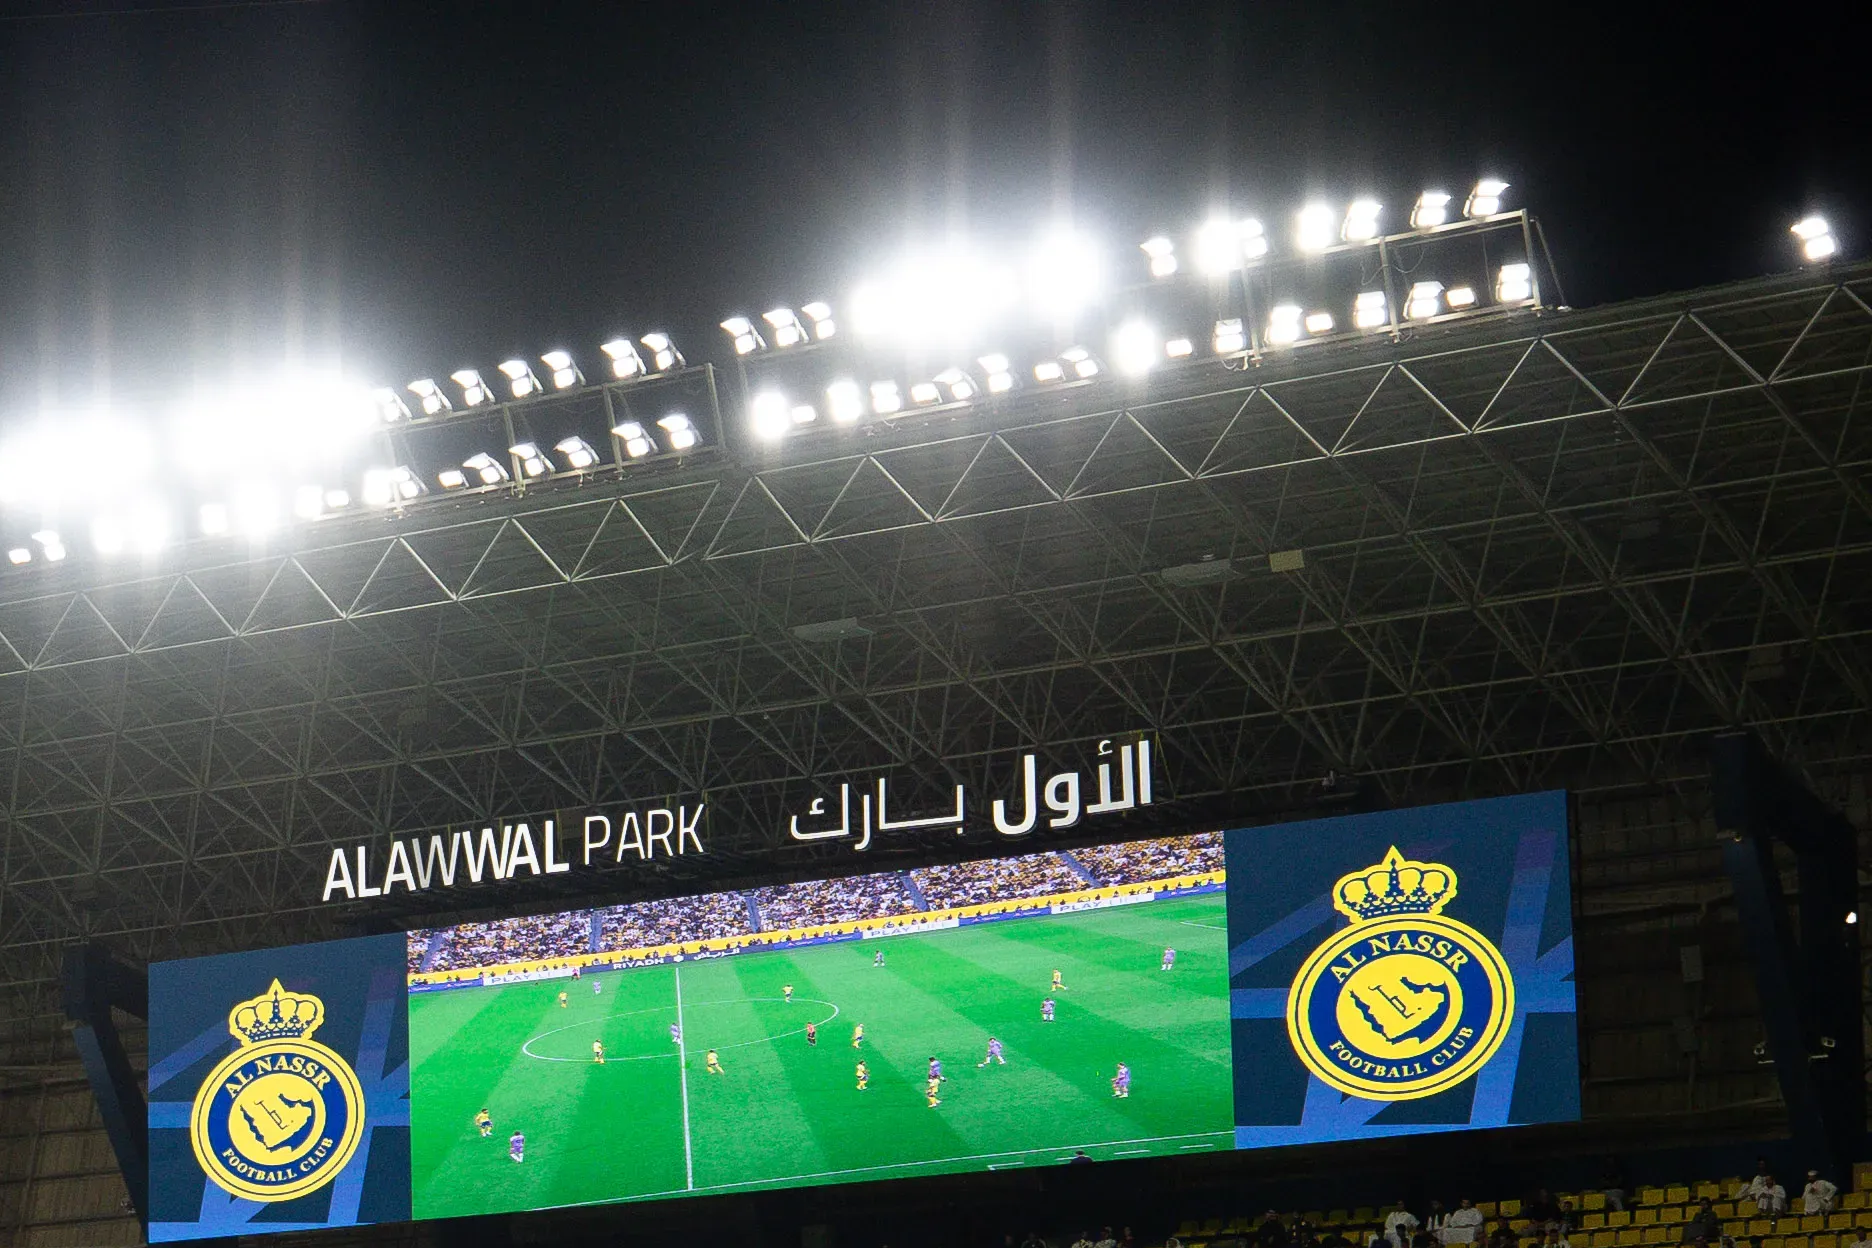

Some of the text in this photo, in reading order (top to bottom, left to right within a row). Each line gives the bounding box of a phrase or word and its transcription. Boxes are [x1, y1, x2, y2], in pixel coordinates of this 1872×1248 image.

[790, 739, 1152, 851] الأول بارك
[322, 803, 705, 902] ALAWWAL PARK
[613, 957, 664, 970] RIYADH
[1329, 932, 1470, 984] AL NASSR
[225, 1054, 332, 1099] AL NASSR
[1328, 1026, 1474, 1079] FOOTBALL CLUB
[222, 1137, 334, 1183] FOOTBALL CLUB
